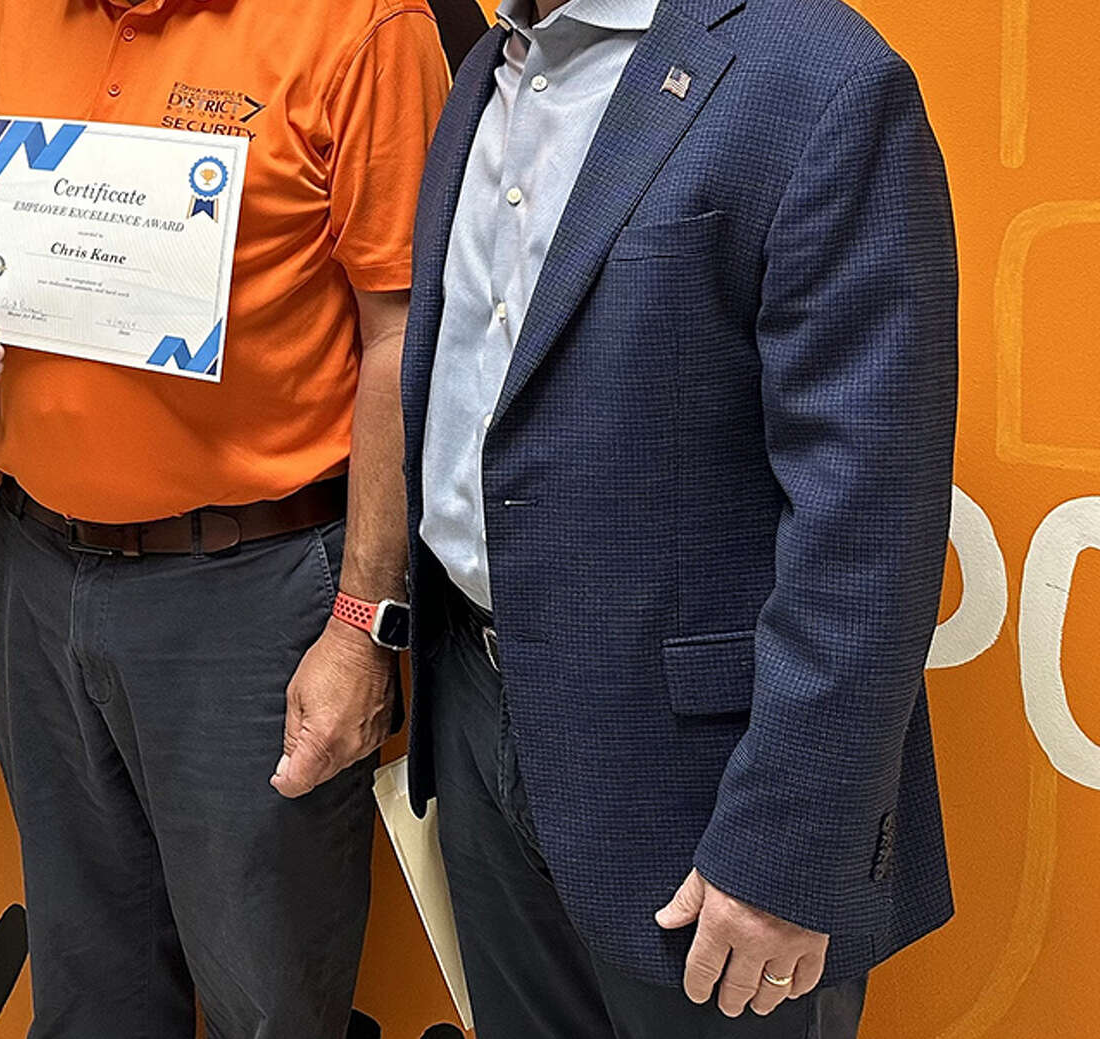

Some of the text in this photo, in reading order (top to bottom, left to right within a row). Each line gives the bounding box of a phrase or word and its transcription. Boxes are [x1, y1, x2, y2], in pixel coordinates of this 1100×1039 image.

[160, 115, 257, 142] SECURITY
[53, 177, 147, 206] Certificate
[13, 200, 185, 233] EMPLOYEE EXCELLENCE AWARD
[50, 241, 127, 265] Chris Kane
